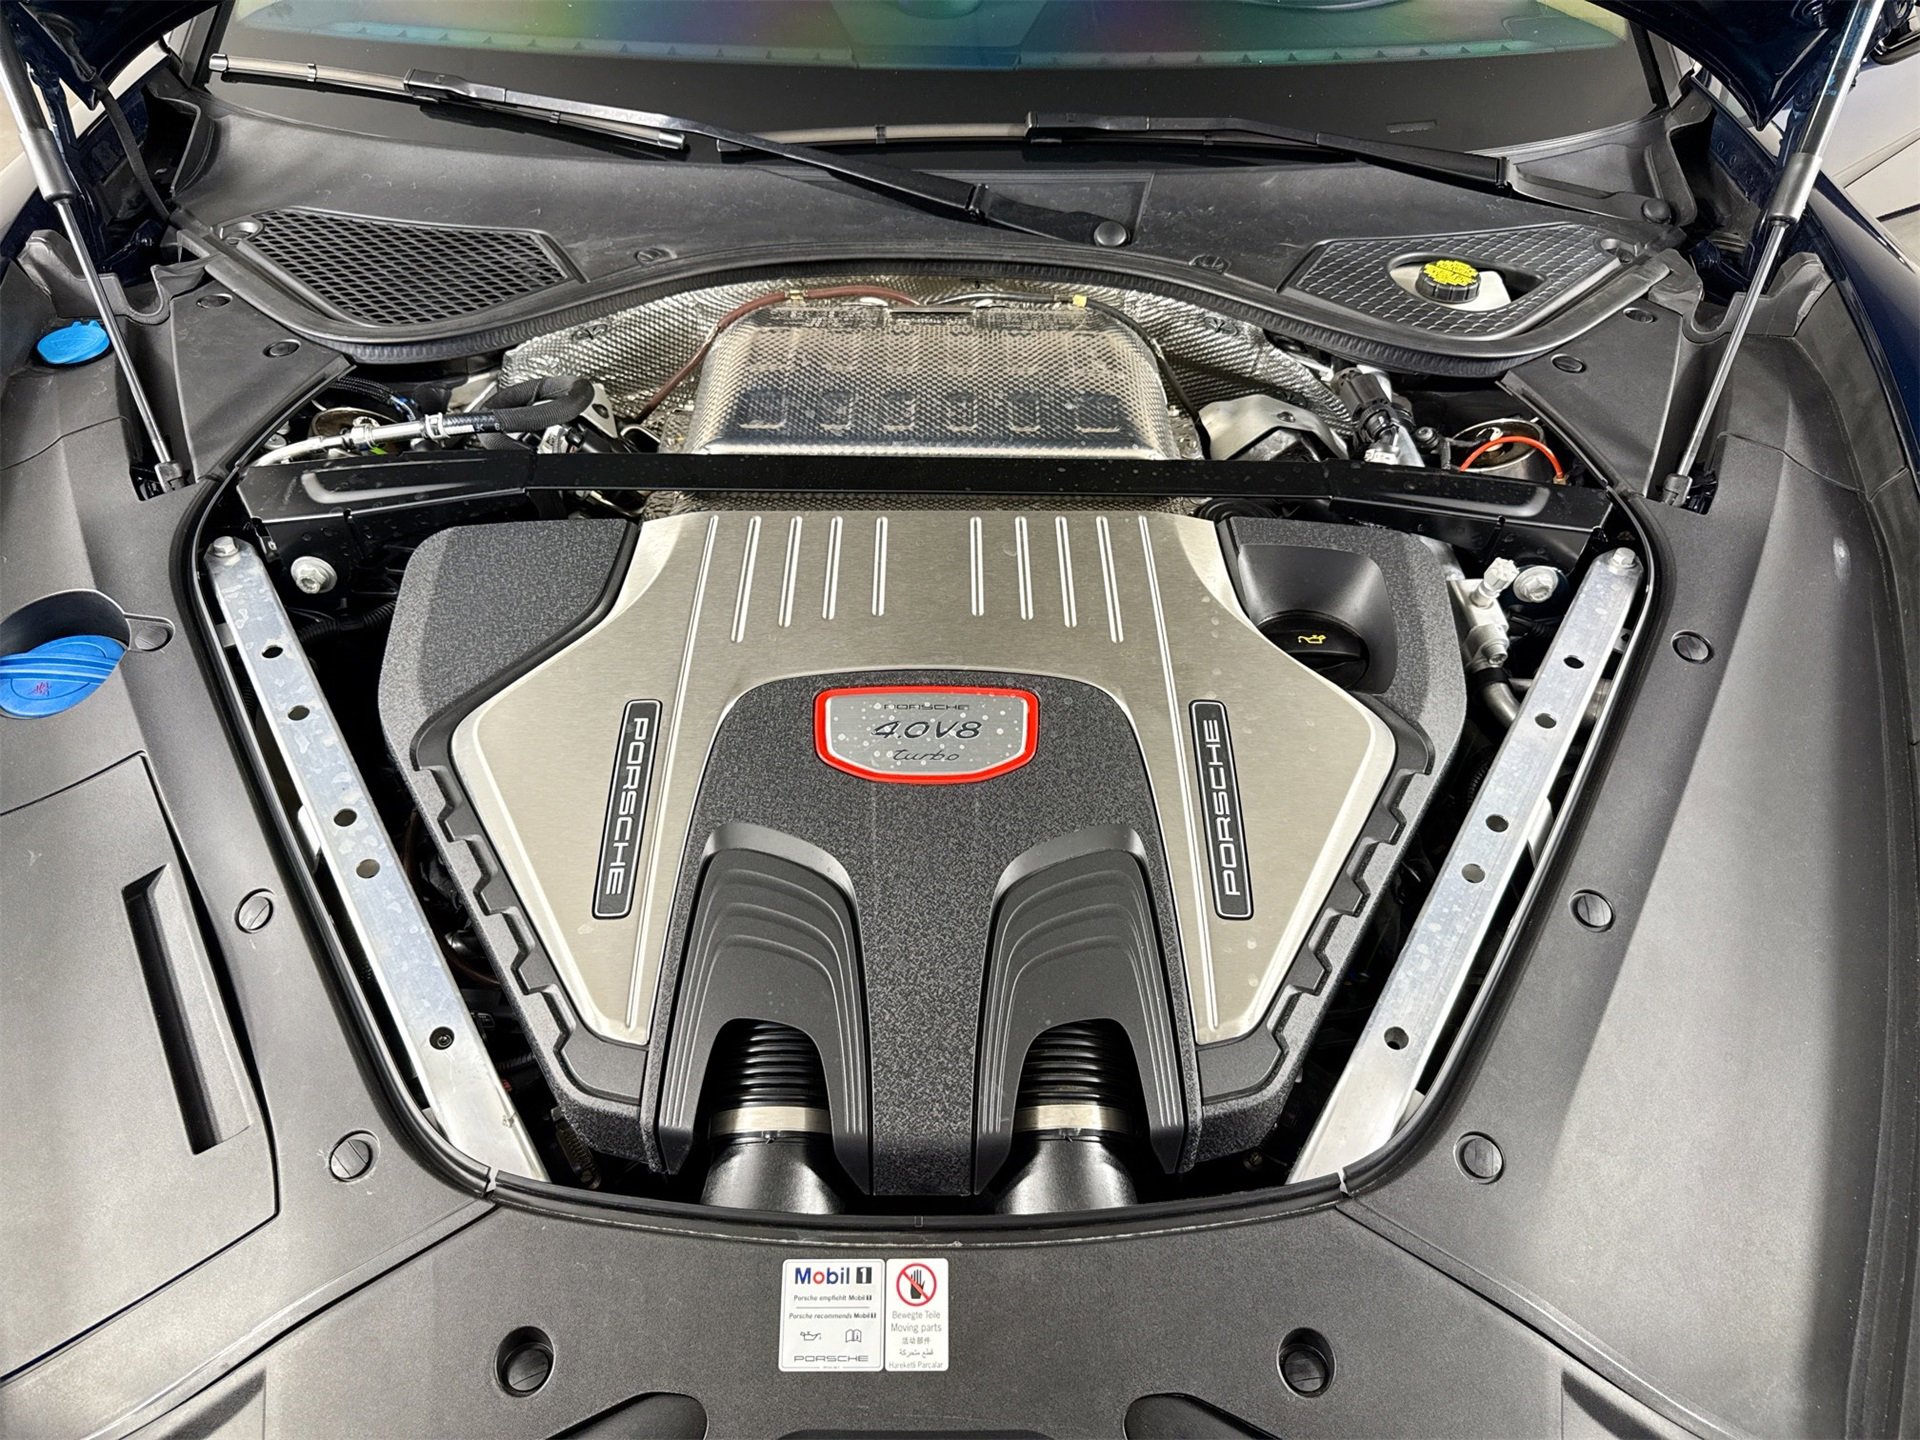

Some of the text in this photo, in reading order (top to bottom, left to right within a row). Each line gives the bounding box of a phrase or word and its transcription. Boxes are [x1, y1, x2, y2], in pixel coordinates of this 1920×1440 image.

[884, 703, 970, 711] PORSCHE
[892, 749, 960, 761] turbo
[605, 717, 650, 895] PORSCHE
[1203, 719, 1241, 896] PORSCHE
[795, 1267, 872, 1284] Mobil 1
[892, 1310, 941, 1320] Bewegte Teile
[891, 1323, 942, 1334] Moving parts
